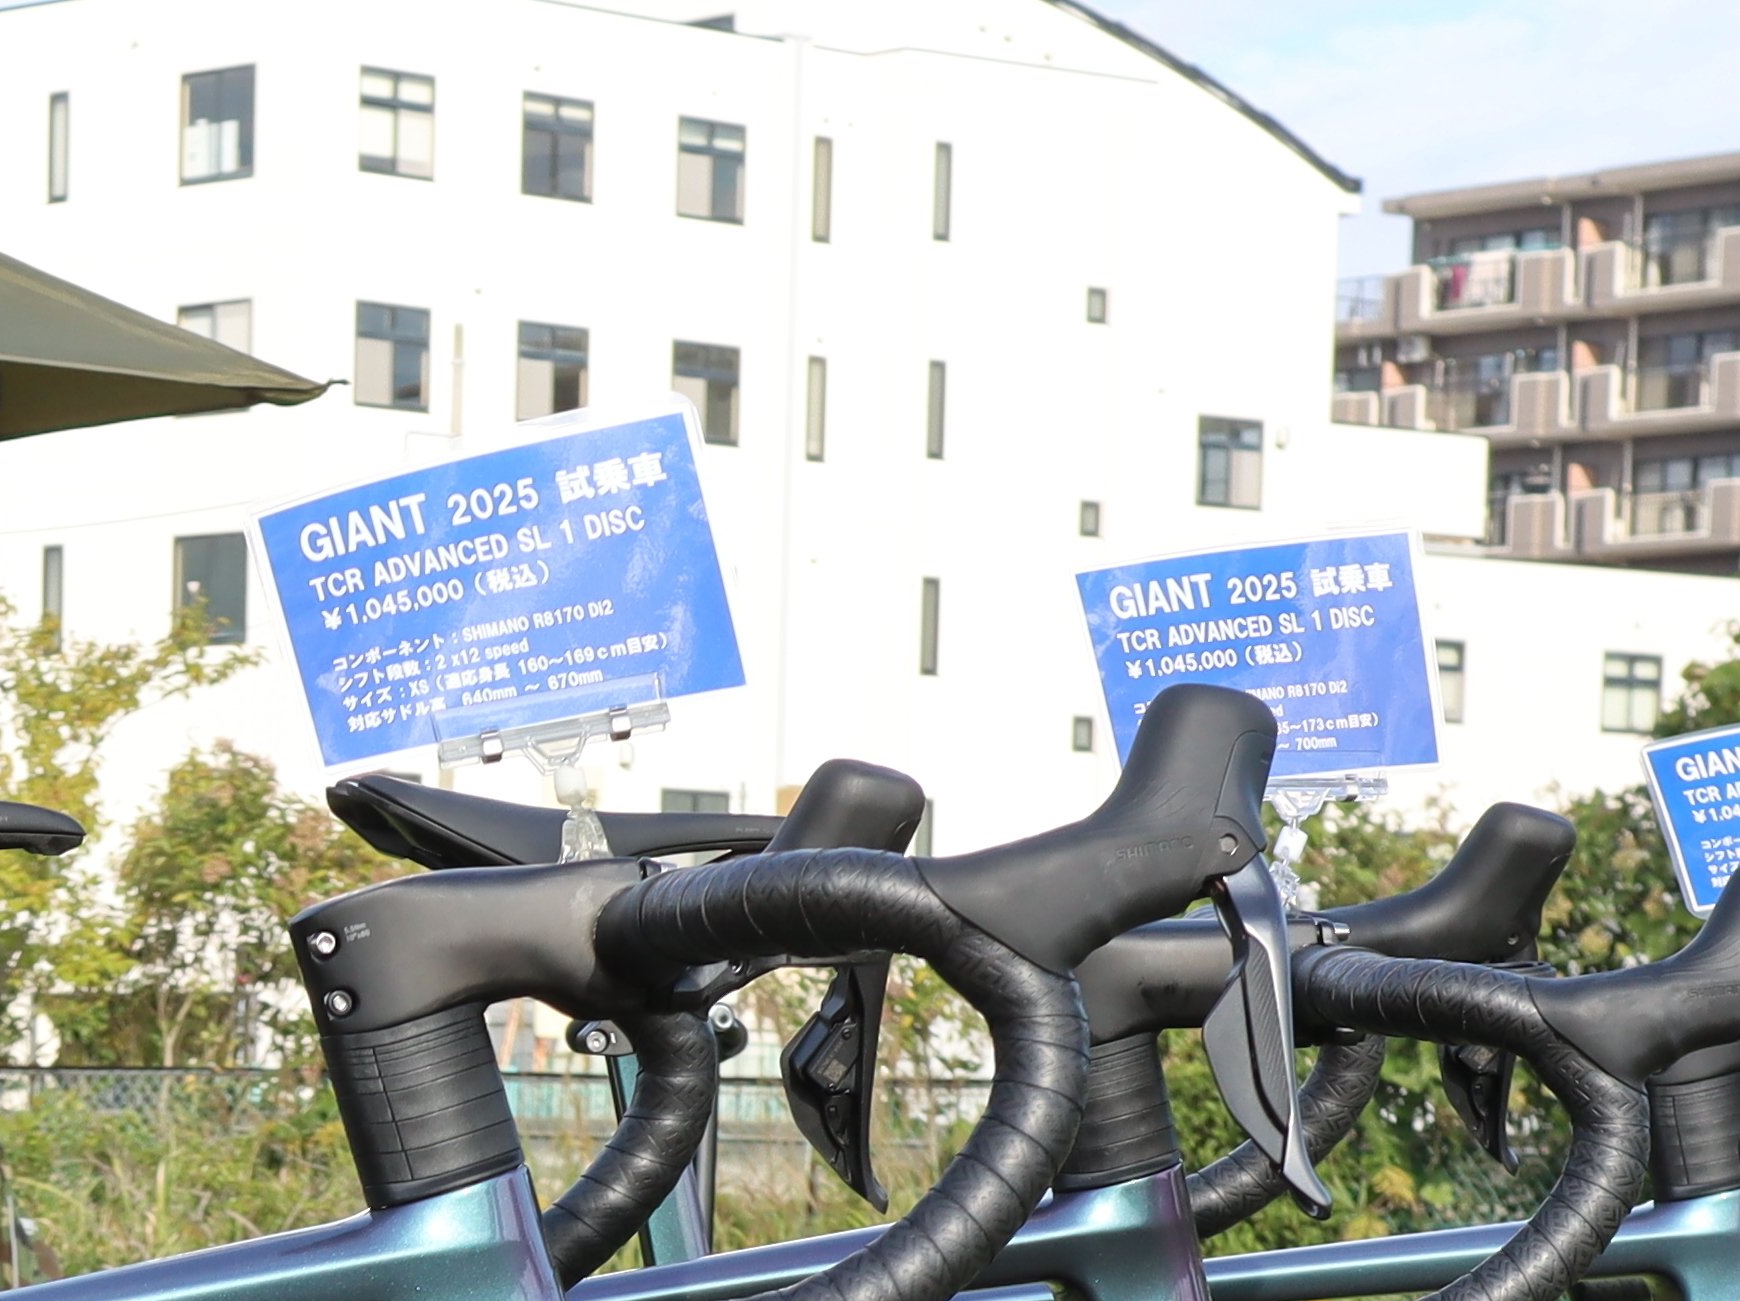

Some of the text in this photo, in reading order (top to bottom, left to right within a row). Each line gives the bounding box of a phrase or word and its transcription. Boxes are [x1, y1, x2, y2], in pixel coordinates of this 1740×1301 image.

[299, 451, 668, 562] GIANT 2025 試乗車
[309, 505, 646, 602] TCR ADVANCED SL 1 DISC
[1109, 562, 1393, 619] GIANT 2025 試乗車
[462, 615, 530, 645] SHIMANO
[533, 604, 585, 631] R8170
[1117, 604, 1375, 654] TCR ADVANCED SL 1 DISC
[485, 638, 530, 665] speed
[461, 682, 518, 707] 640mm
[547, 668, 605, 691] 670mm
[1287, 680, 1348, 699] R8170 Di2
[1295, 736, 1337, 751] 700mm
[1683, 788, 1722, 808] TCR
[1116, 834, 1194, 861] SHIMANO
